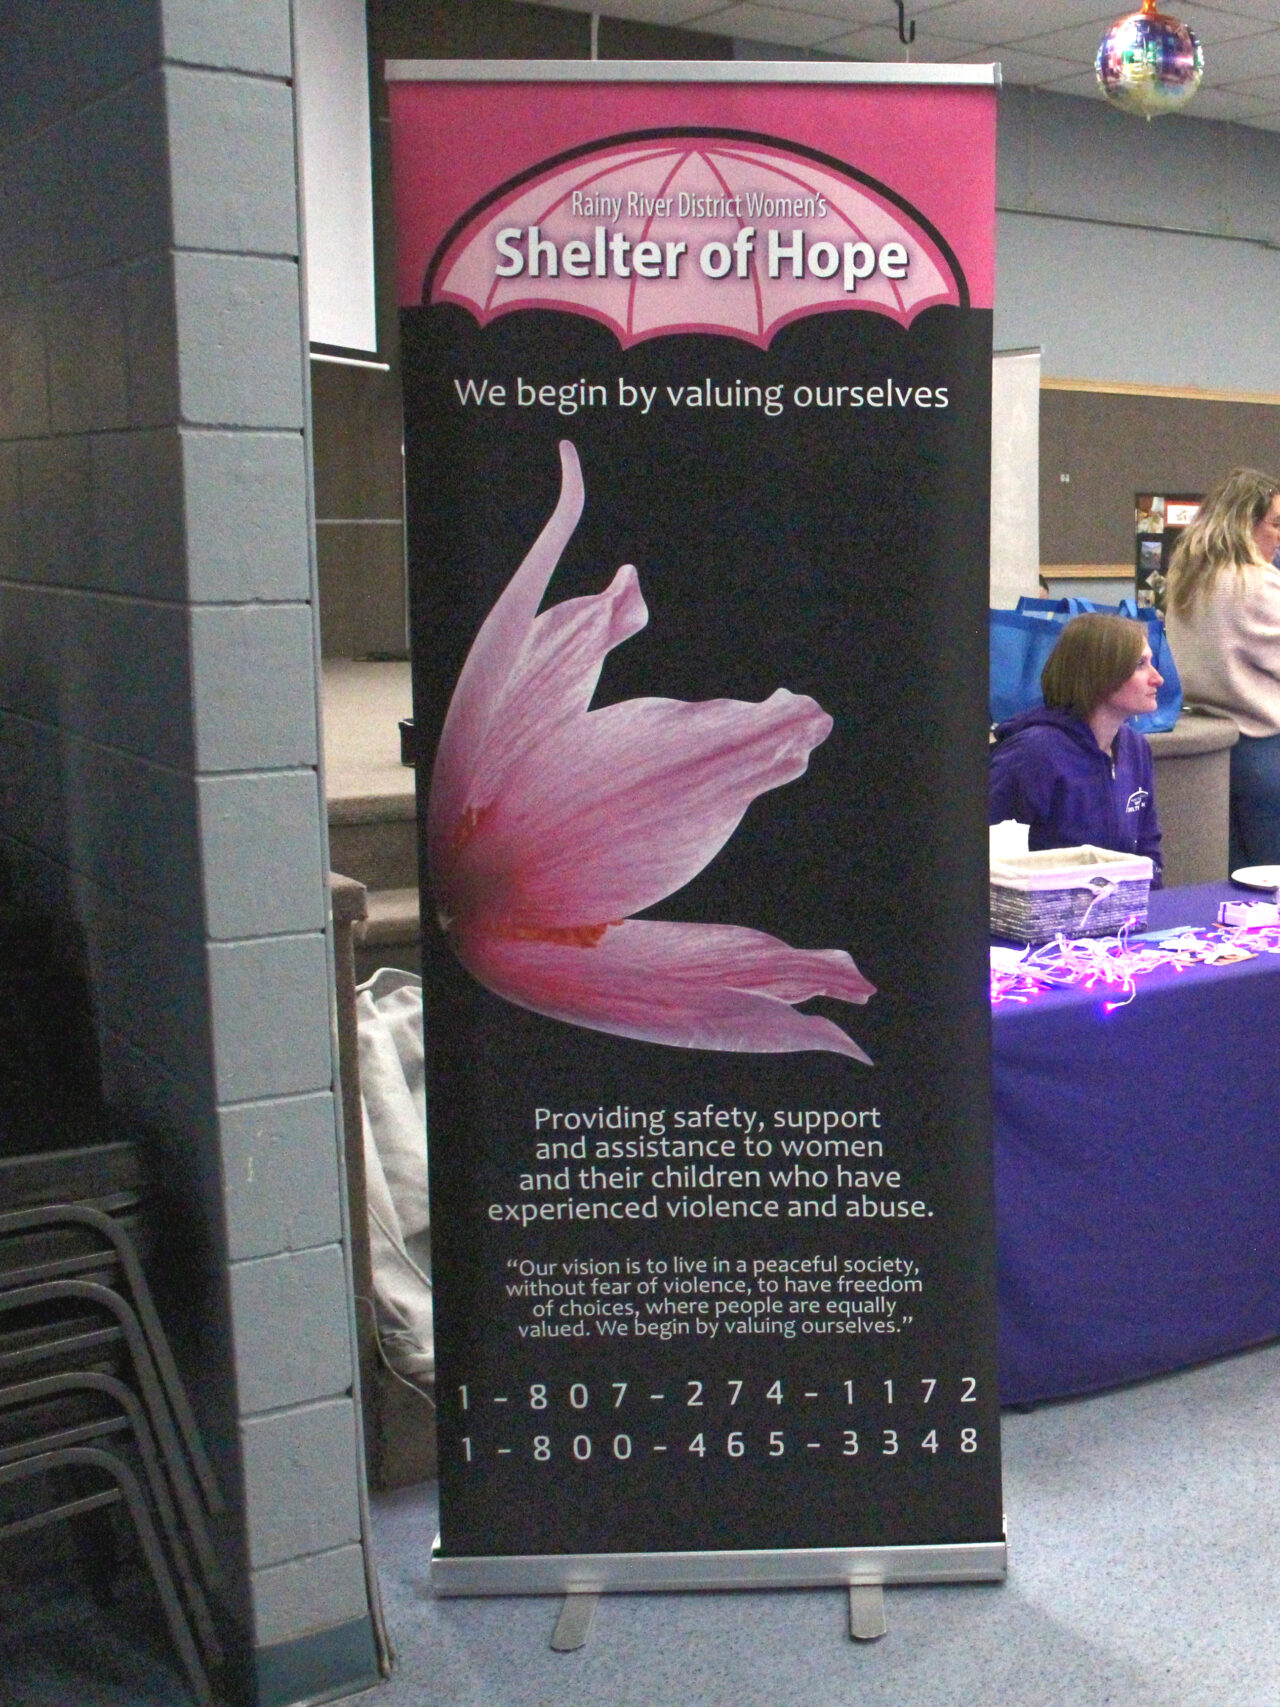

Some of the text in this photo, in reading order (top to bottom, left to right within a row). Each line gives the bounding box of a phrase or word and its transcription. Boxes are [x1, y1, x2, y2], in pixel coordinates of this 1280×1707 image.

[572, 190, 622, 224] Rainy
[628, 191, 673, 219] River
[678, 192, 742, 219] District
[496, 226, 909, 292] Shelter of Hope
[454, 377, 949, 417] We begin by valuing ourselves
[535, 1103, 881, 1135] Providing safety, support
[536, 1135, 883, 1160] and assistance to women
[519, 1164, 901, 1191] and their children who have
[488, 1194, 934, 1226] experienced violence and abuse.
[562, 1261, 620, 1275] vision
[626, 1261, 641, 1274] is
[646, 1259, 668, 1274] to
[673, 1256, 707, 1273] live
[713, 1260, 730, 1273] in
[736, 1259, 747, 1273] a
[753, 1254, 838, 1276] peaceful
[843, 1257, 919, 1277] society,
[506, 1275, 923, 1296] without fear of violence, to have freedom
[532, 1296, 897, 1319] of choices, where people are equally
[518, 1319, 592, 1338] valued.
[595, 1320, 628, 1336] We
[634, 1318, 690, 1340] begin
[695, 1317, 719, 1339] by
[724, 1316, 796, 1339] valuing
